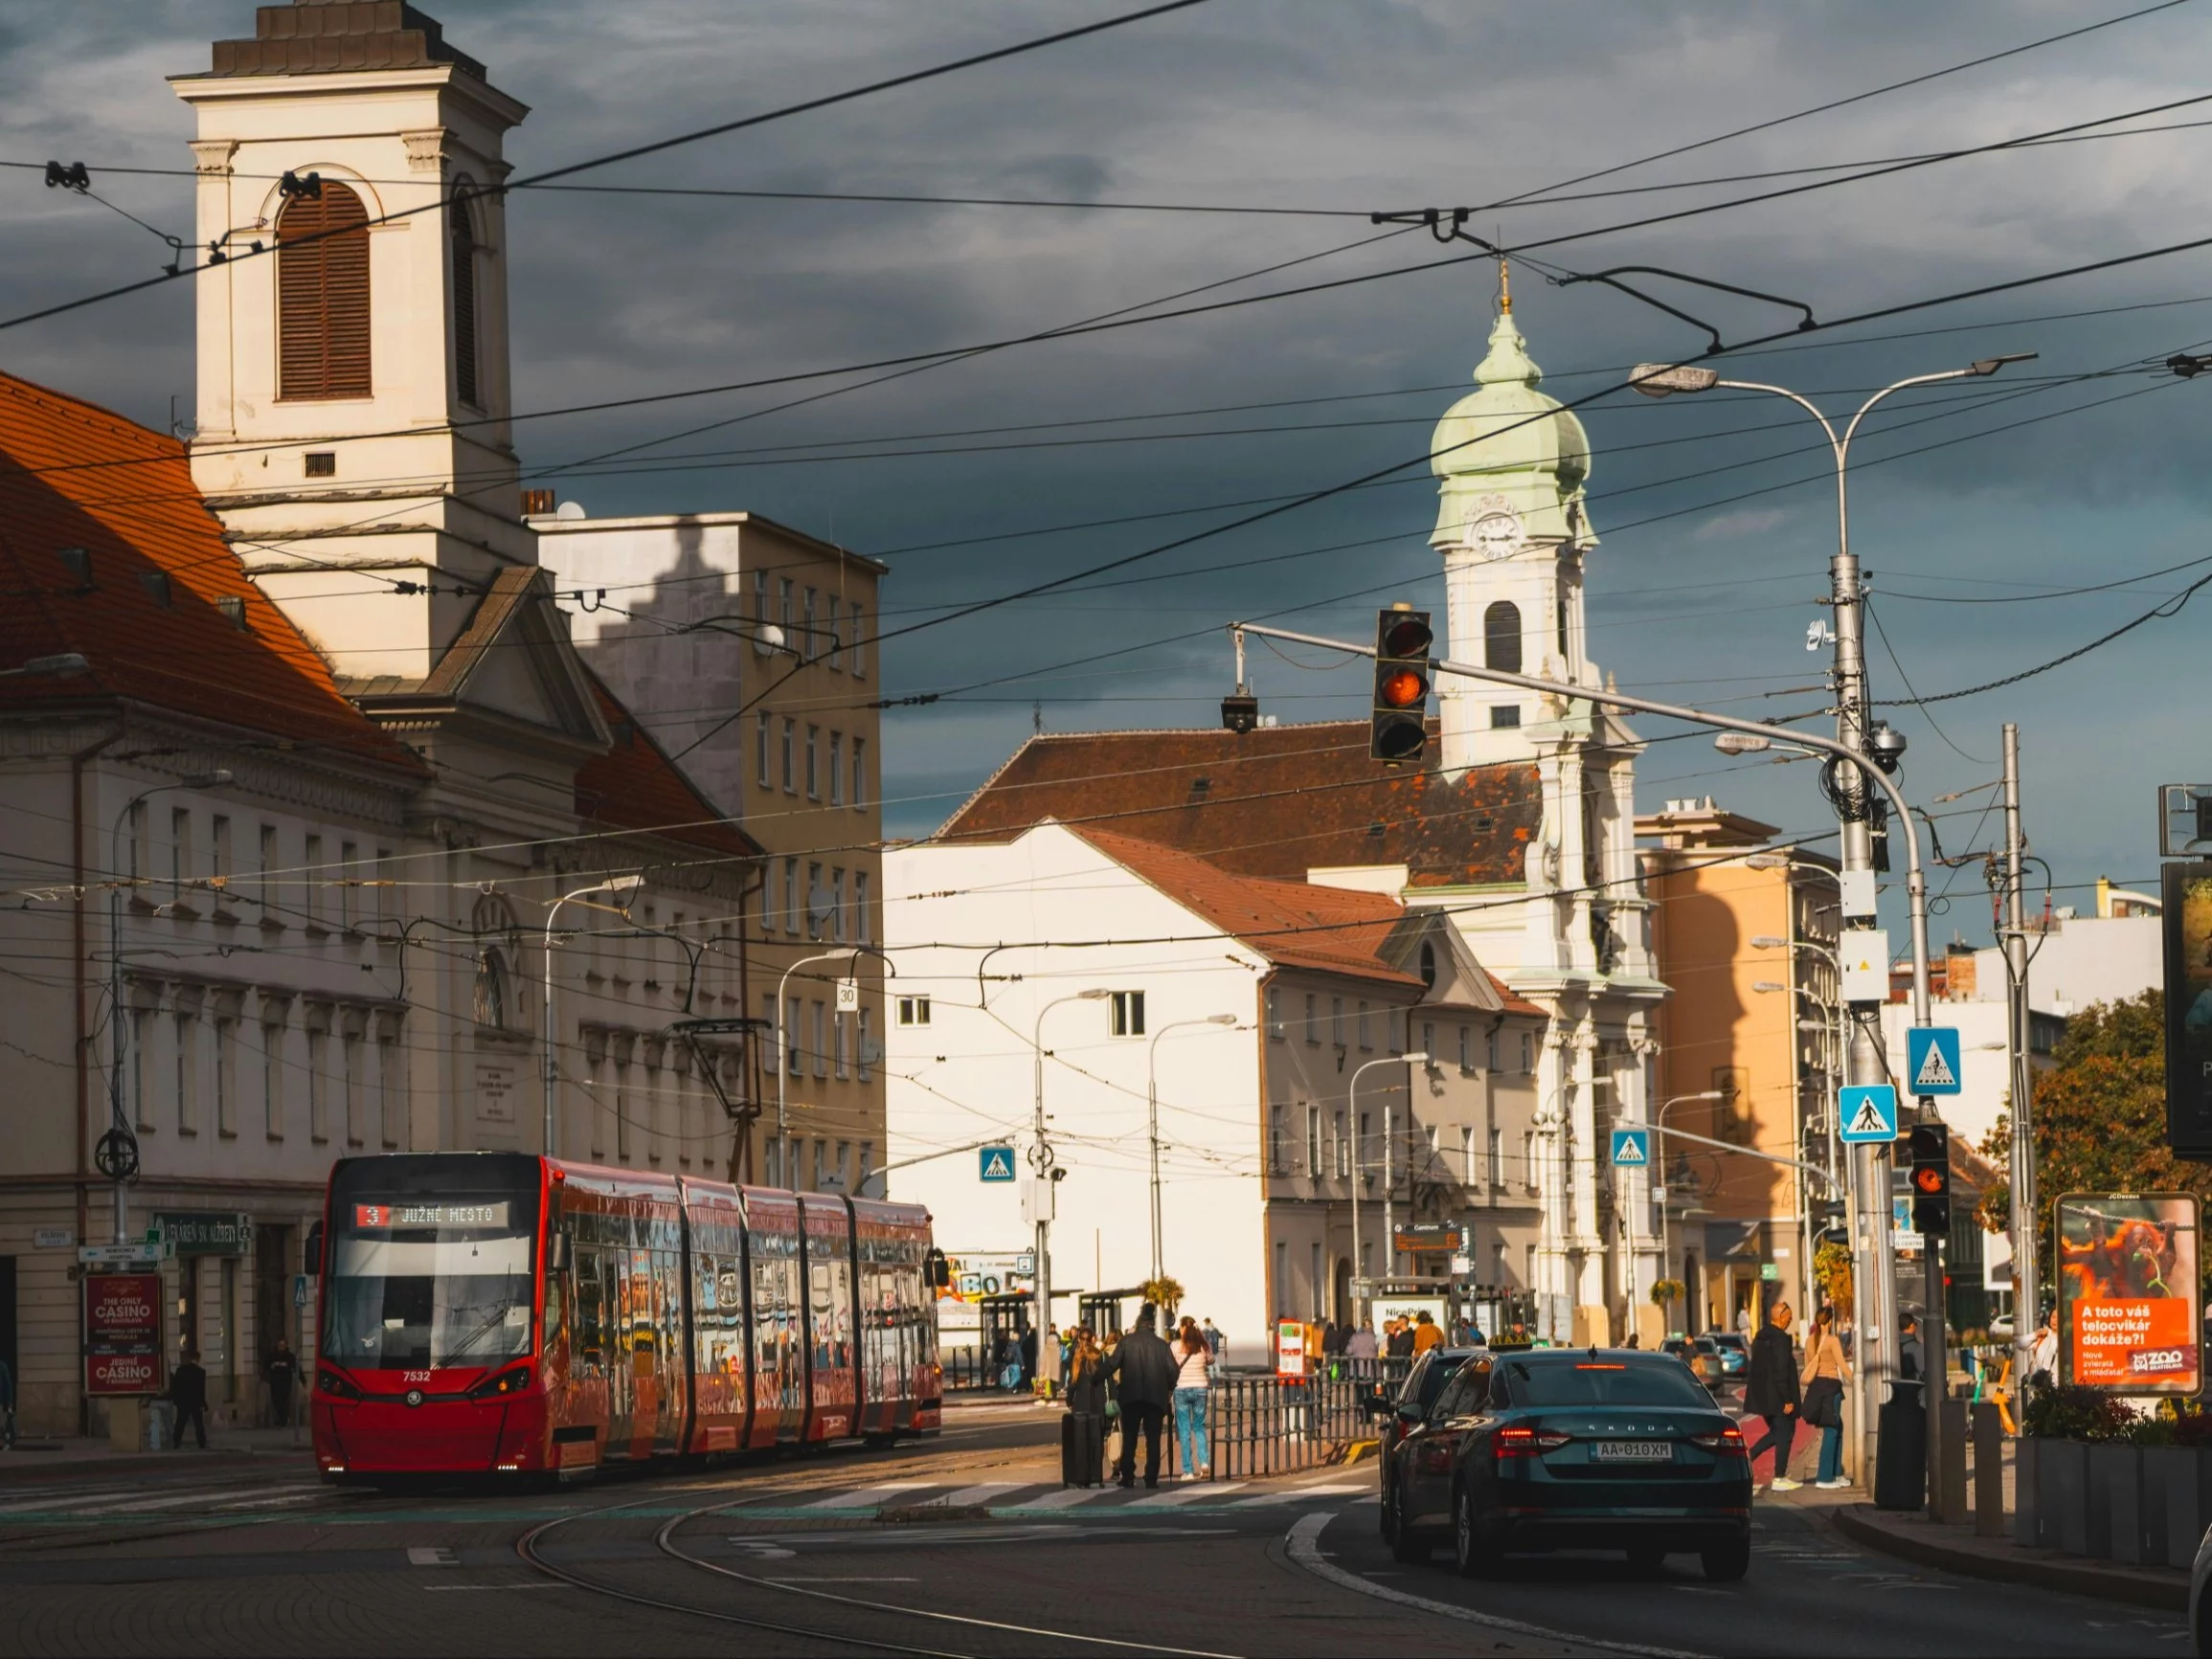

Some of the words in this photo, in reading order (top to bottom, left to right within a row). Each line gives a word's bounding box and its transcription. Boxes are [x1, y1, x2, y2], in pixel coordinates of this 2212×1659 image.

[841, 989, 854, 1002] 30
[367, 1206, 378, 1225] 3
[401, 1205, 442, 1222] JUŽNÉ
[449, 1208, 493, 1222] MESTO
[103, 1297, 118, 1306] THE
[120, 1296, 142, 1305] ONLY
[95, 1305, 150, 1318] CASINO
[2082, 1306, 2092, 1317] A
[2095, 1307, 2123, 1317] toto
[2126, 1305, 2150, 1317] váš
[2082, 1319, 2151, 1332] telocvikár
[2082, 1333, 2145, 1345] dokáže?!
[2148, 1351, 2183, 1365] ZOO
[96, 1366, 151, 1379] CASINO
[403, 1371, 431, 1381] 7532
